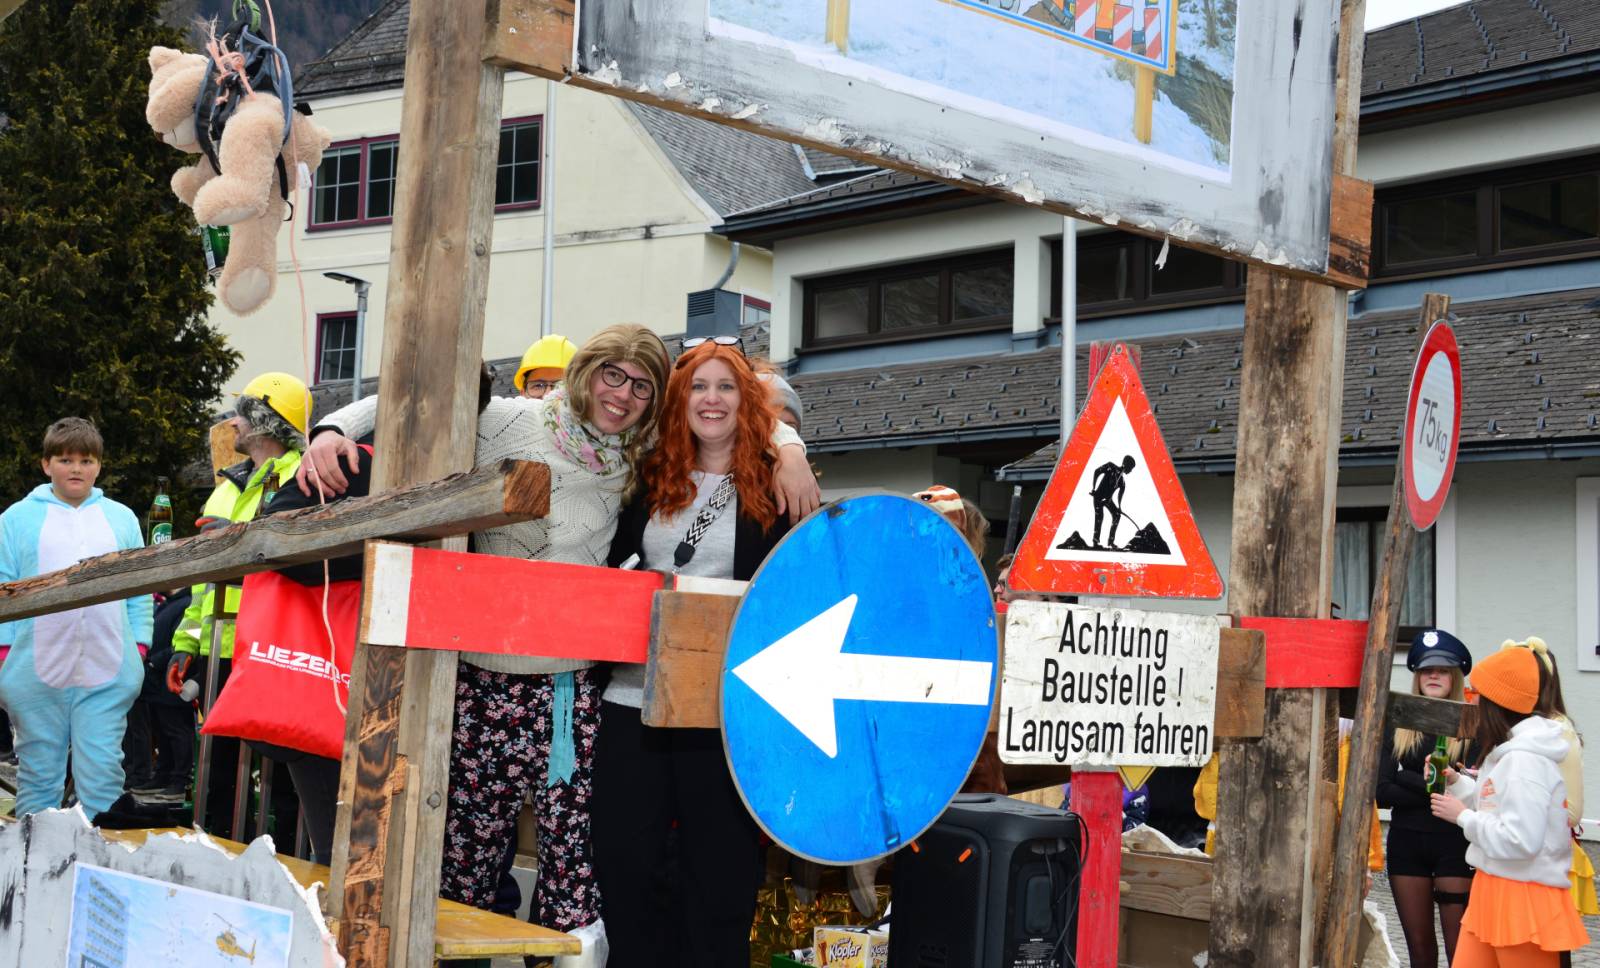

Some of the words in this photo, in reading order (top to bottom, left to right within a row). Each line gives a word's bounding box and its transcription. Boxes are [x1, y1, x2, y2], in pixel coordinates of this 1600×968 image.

[1420, 398, 1447, 463] 75kg
[1059, 610, 1168, 671] Achtung
[1042, 658, 1167, 706] Baustelle
[1006, 707, 1125, 762] Langsam
[1134, 711, 1208, 755] fahren
